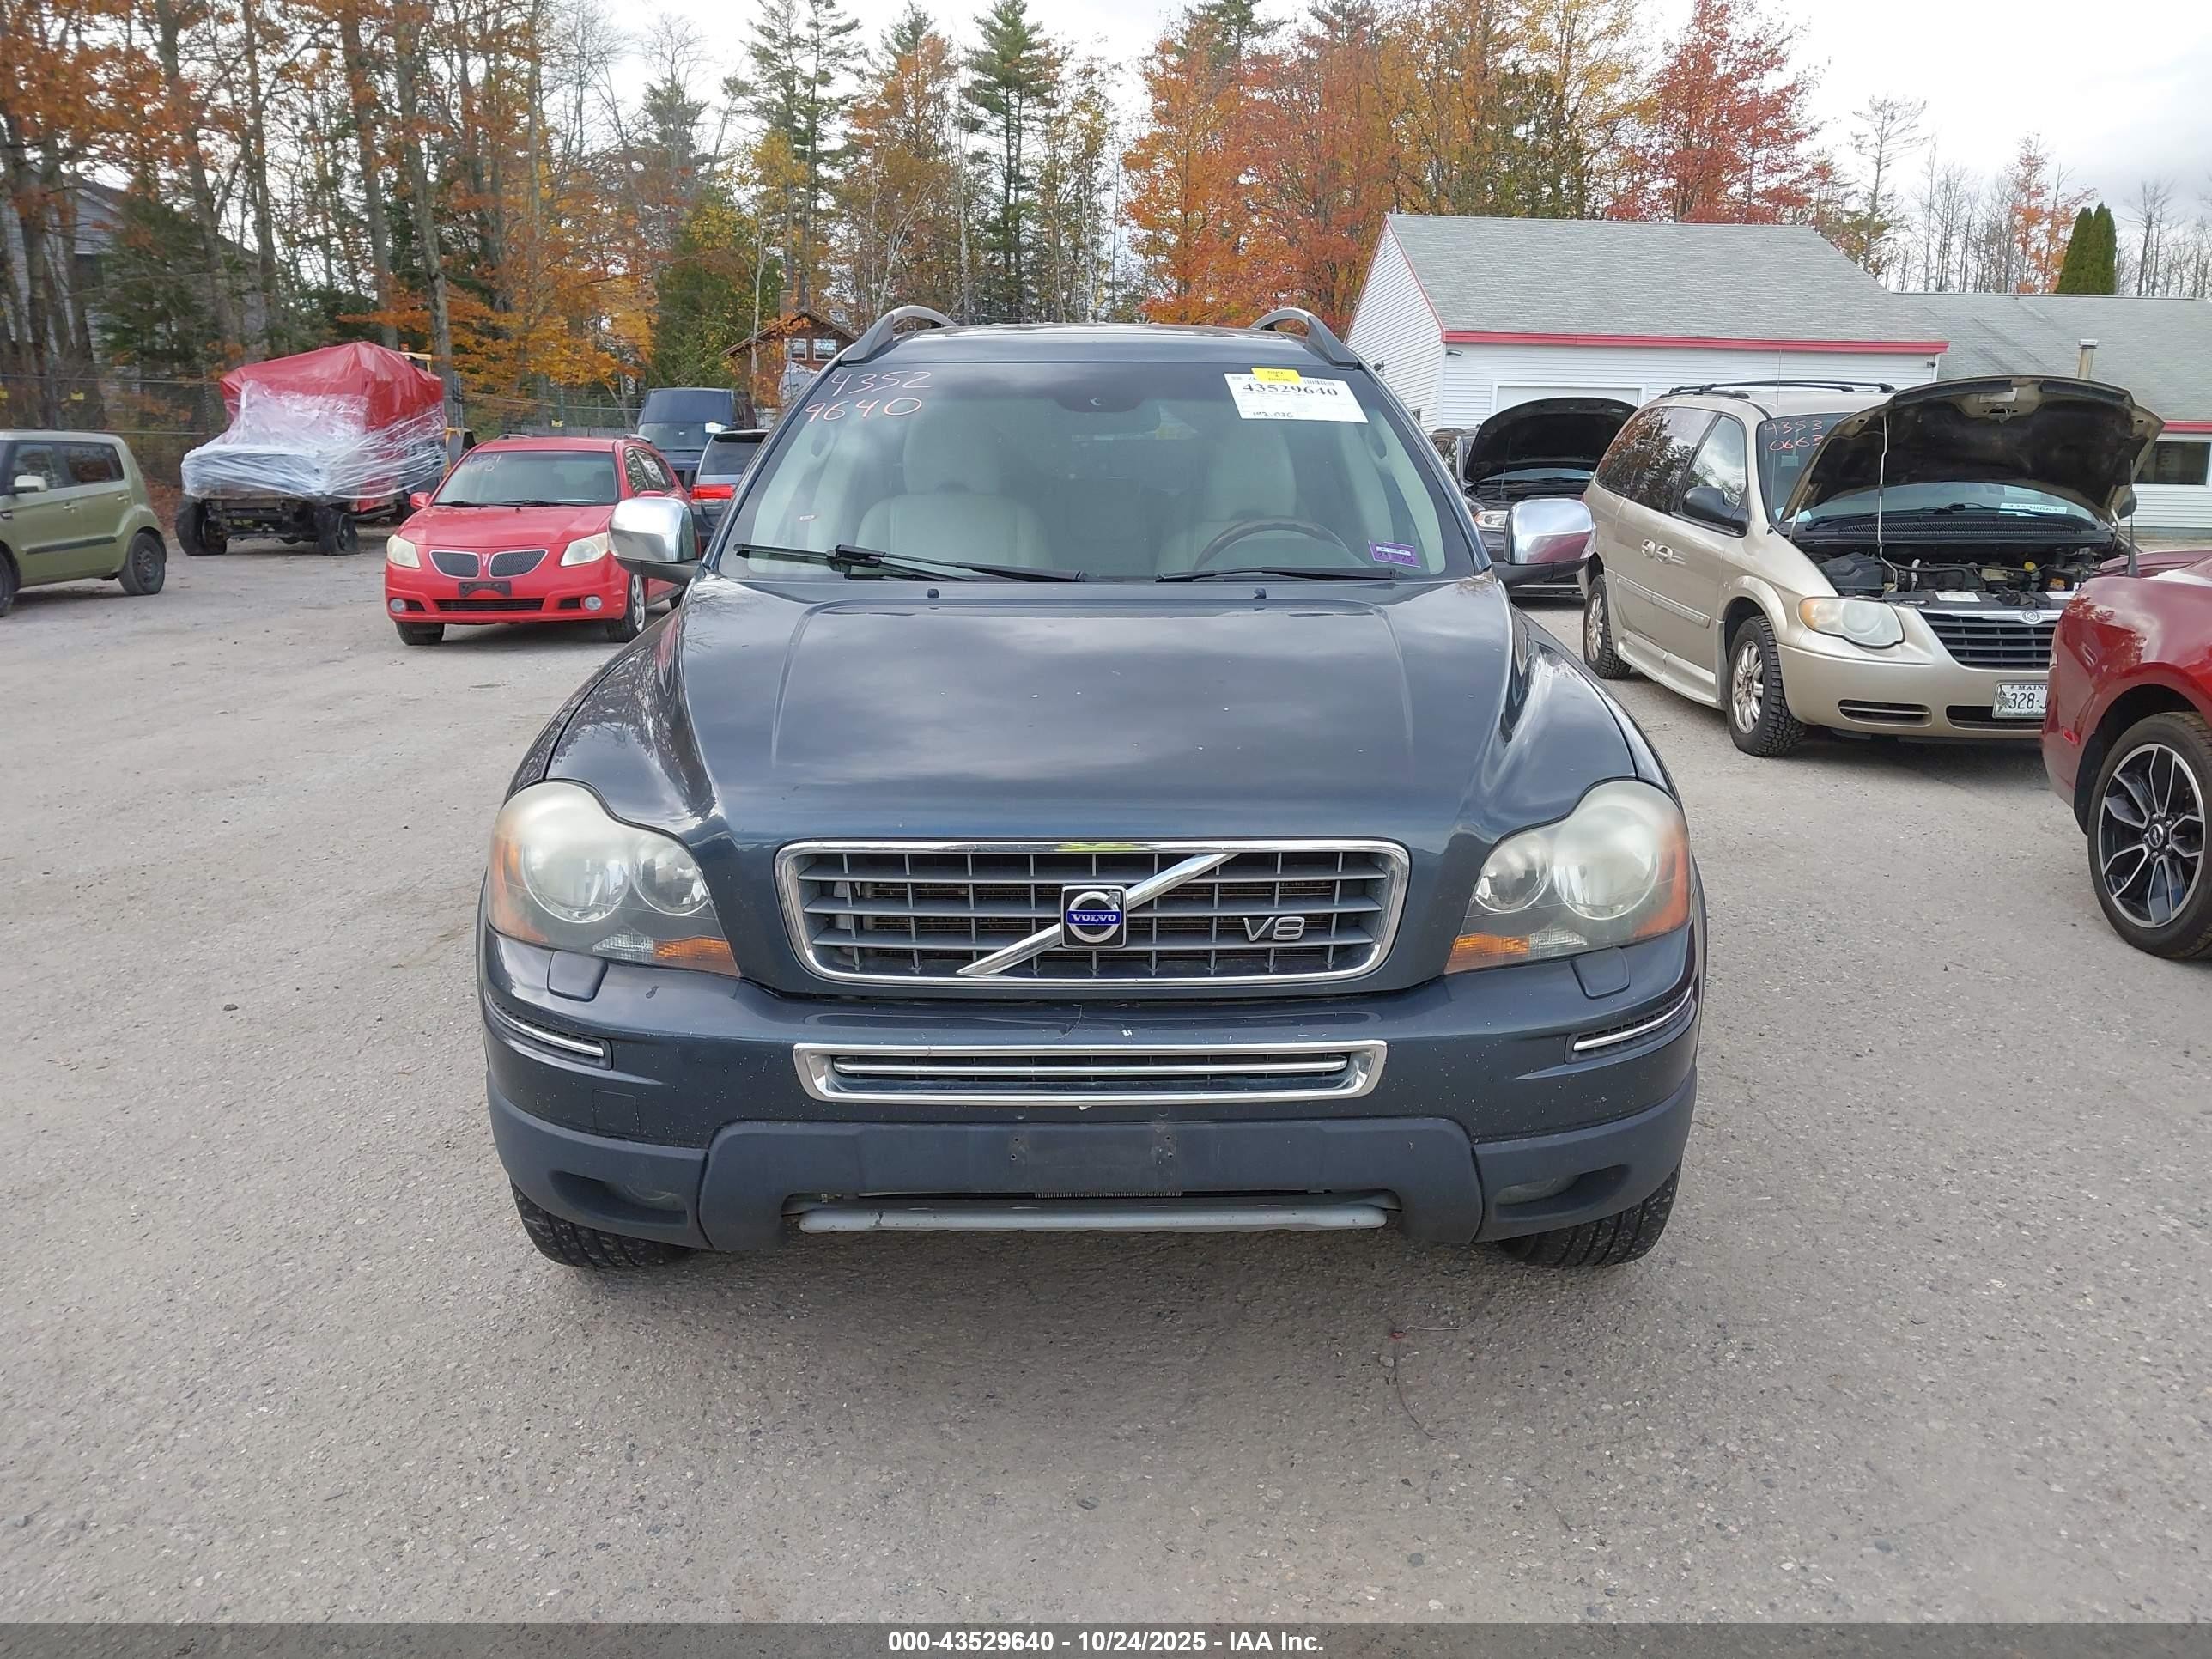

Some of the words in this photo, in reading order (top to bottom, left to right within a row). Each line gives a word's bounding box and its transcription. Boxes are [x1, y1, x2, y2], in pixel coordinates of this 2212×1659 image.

[831, 370, 933, 397] 4352
[1243, 383, 1338, 396] 43529640
[805, 397, 922, 422] 9640
[1765, 419, 1823, 435] 4353
[1769, 434, 1824, 451] 0663
[1243, 916, 1305, 942] V8
